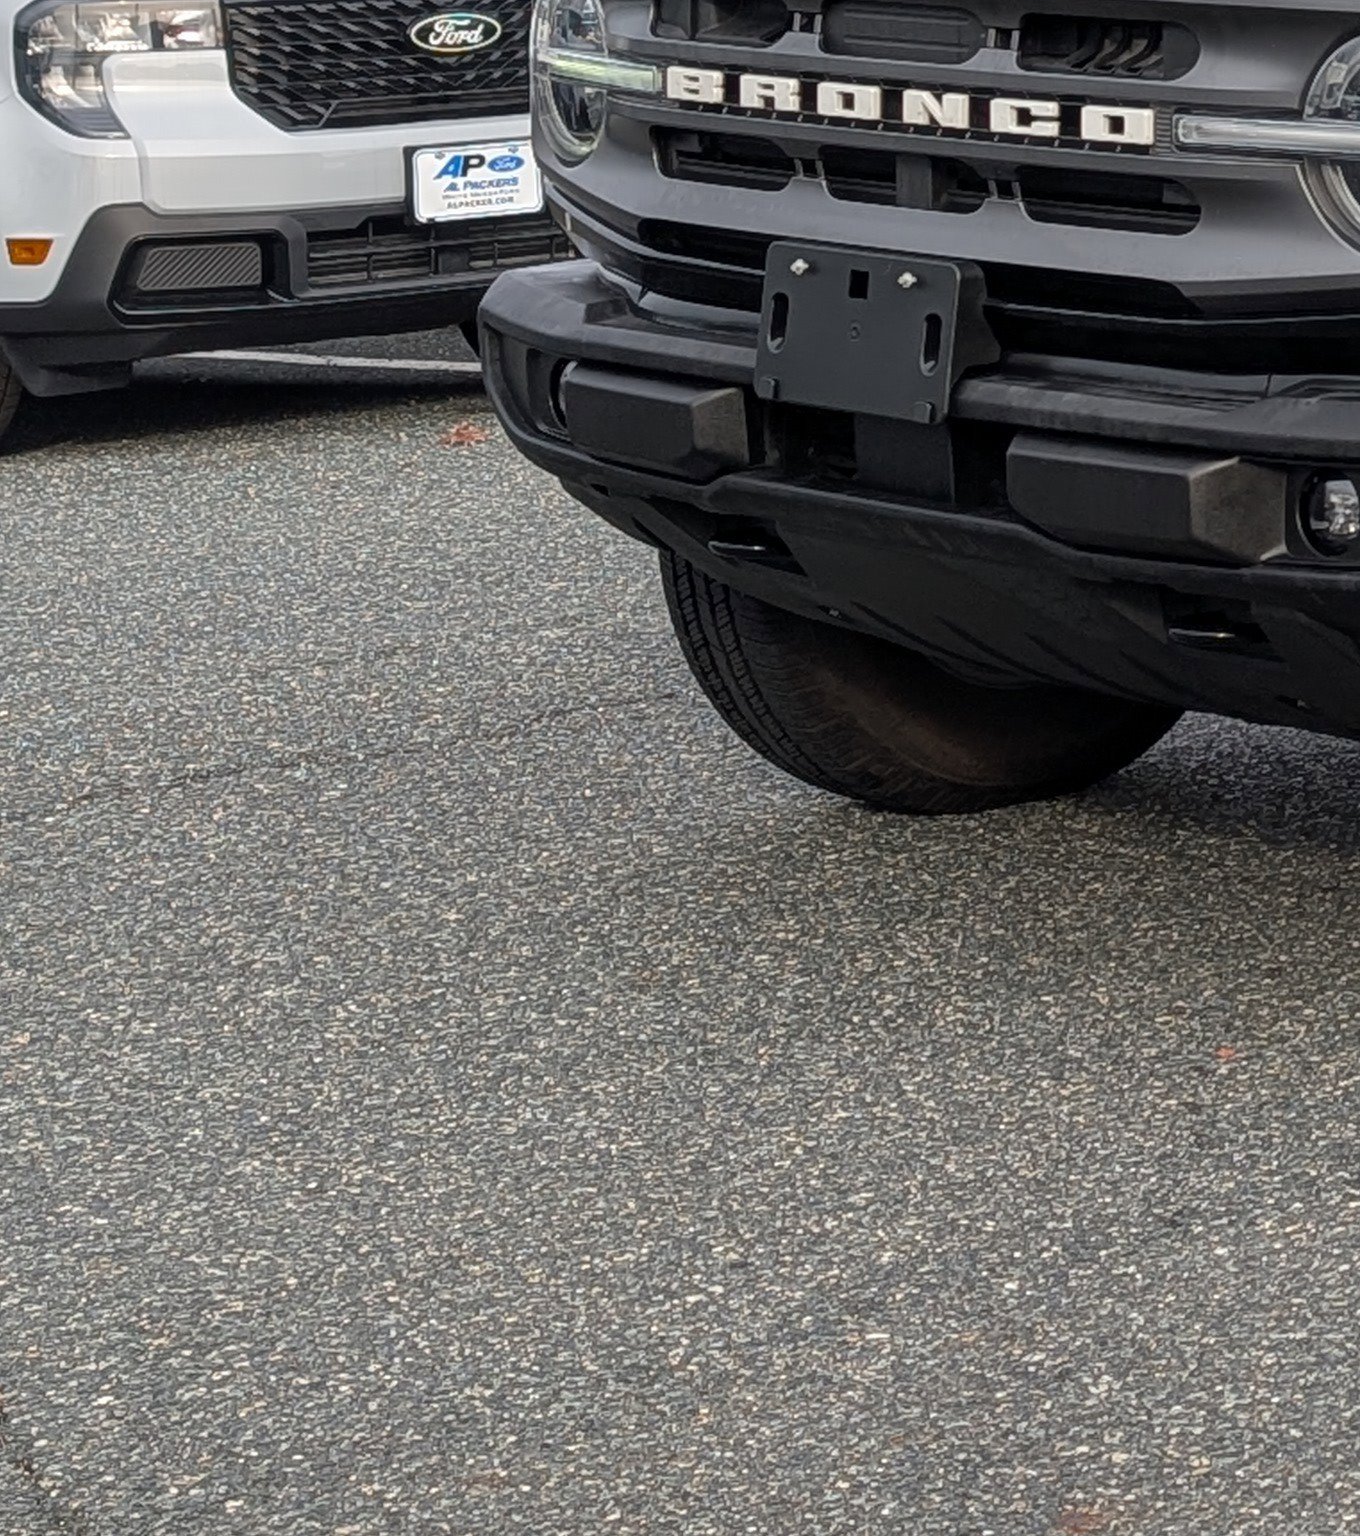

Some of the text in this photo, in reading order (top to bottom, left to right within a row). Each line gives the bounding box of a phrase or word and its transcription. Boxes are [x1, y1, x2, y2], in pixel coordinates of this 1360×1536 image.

[429, 19, 485, 45] Ford
[667, 66, 1155, 145] BRONCO
[433, 154, 486, 180] AP
